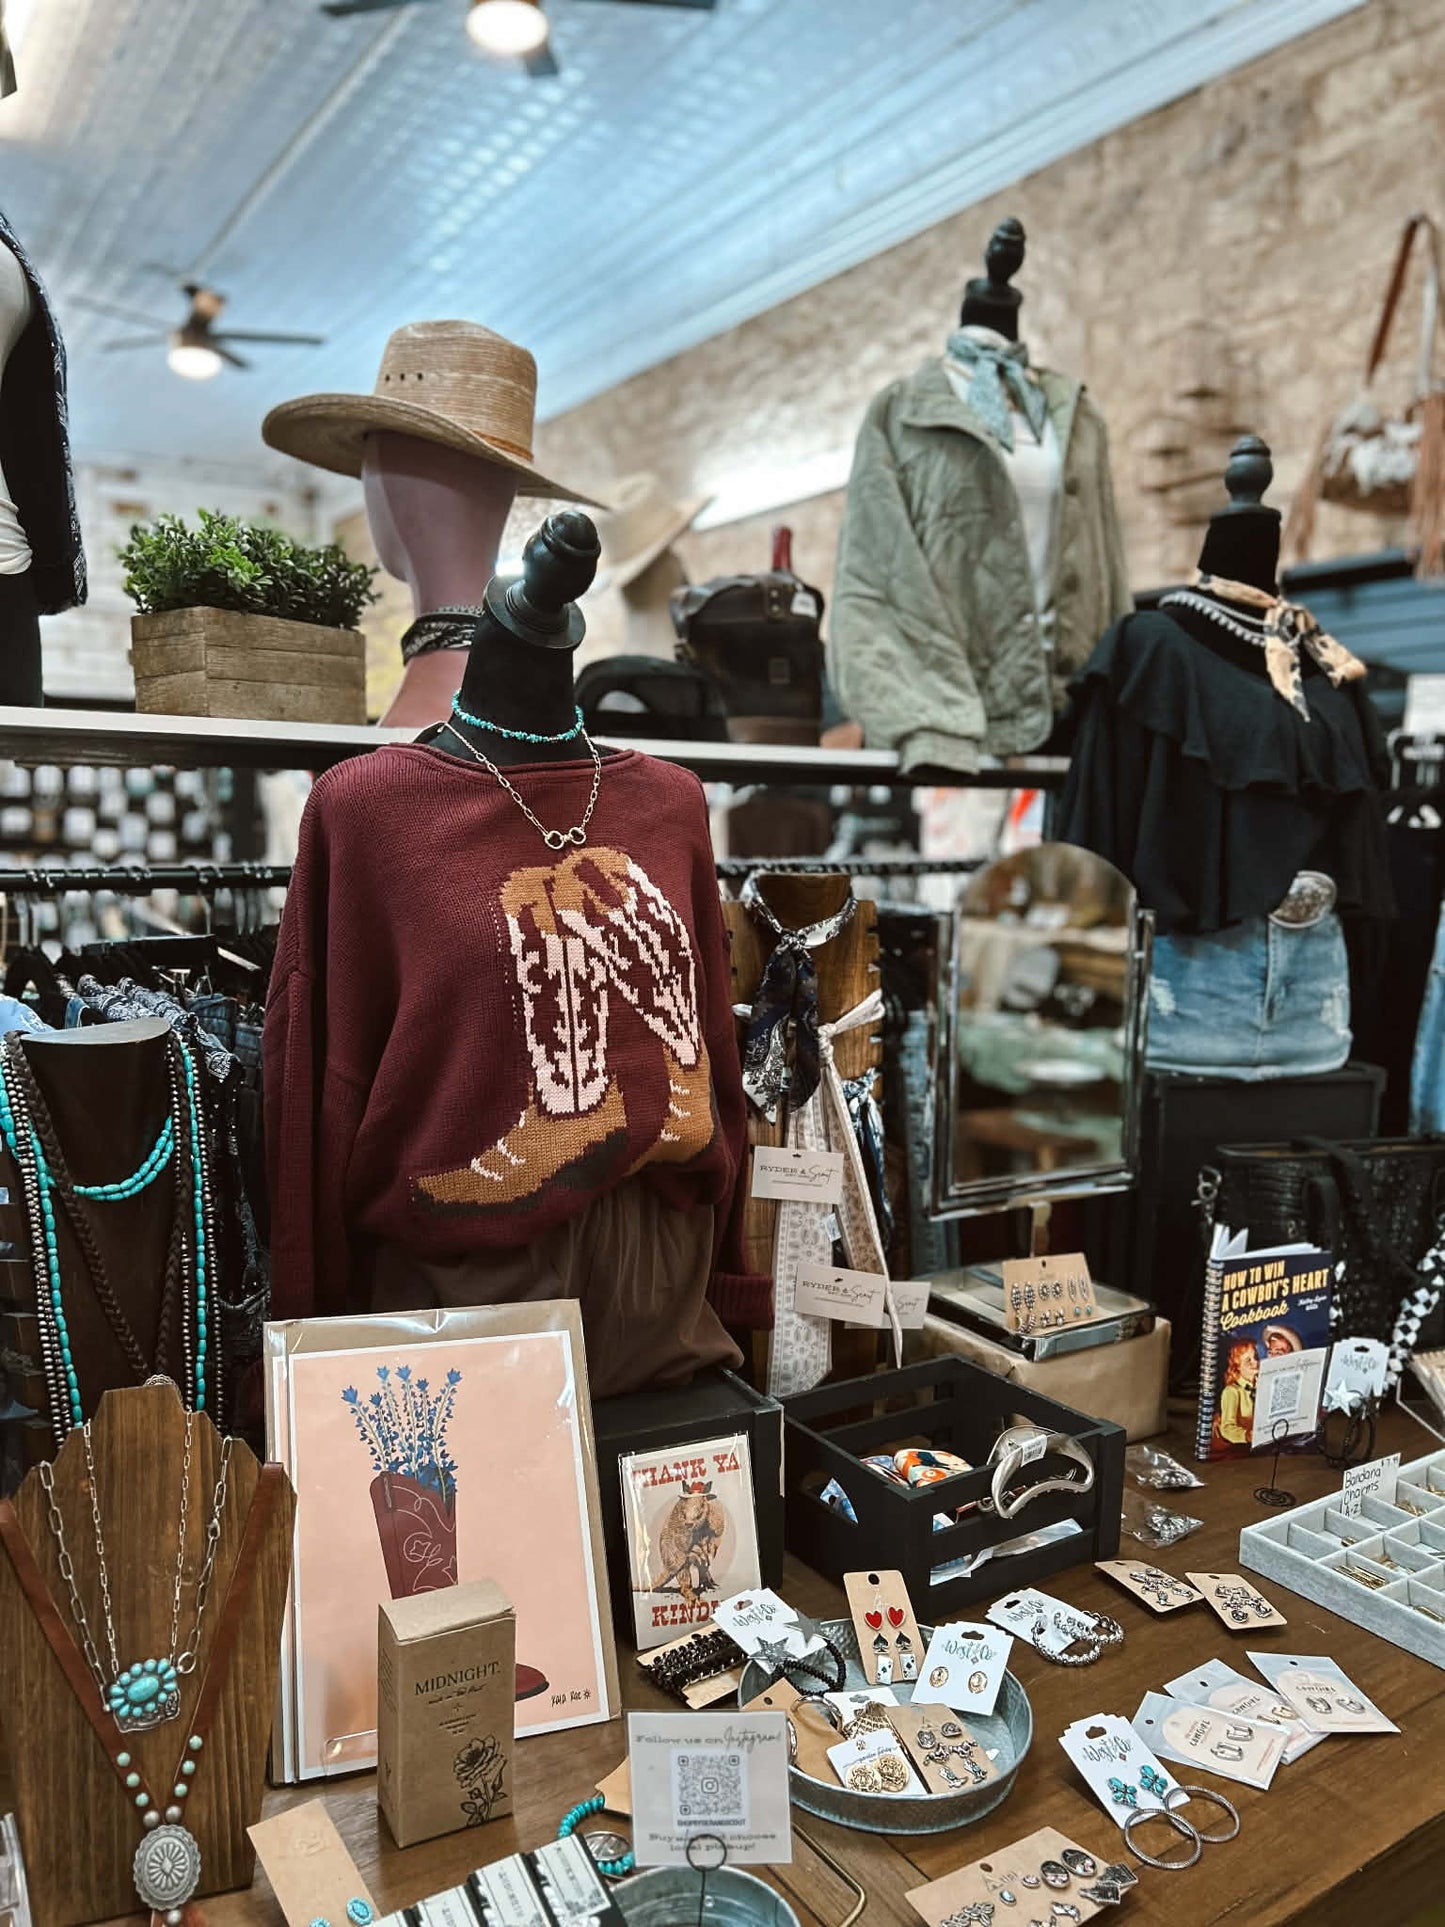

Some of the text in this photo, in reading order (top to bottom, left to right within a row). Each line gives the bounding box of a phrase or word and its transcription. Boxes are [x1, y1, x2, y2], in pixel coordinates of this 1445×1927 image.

[760, 1165, 798, 1174] RYDER
[802, 1280, 839, 1293] RYDER
[1223, 1260, 1286, 1291] HOW TO WIN
[1221, 1293, 1230, 1313] A
[1232, 1277, 1290, 1310] COWBOY'S
[1292, 1268, 1330, 1295] HEART
[1220, 1300, 1289, 1331] Cookbook
[713, 1452, 741, 1474] YA
[652, 1600, 719, 1627] KIND
[635, 1733, 681, 1745] Follow
[705, 1737, 723, 1745] on
